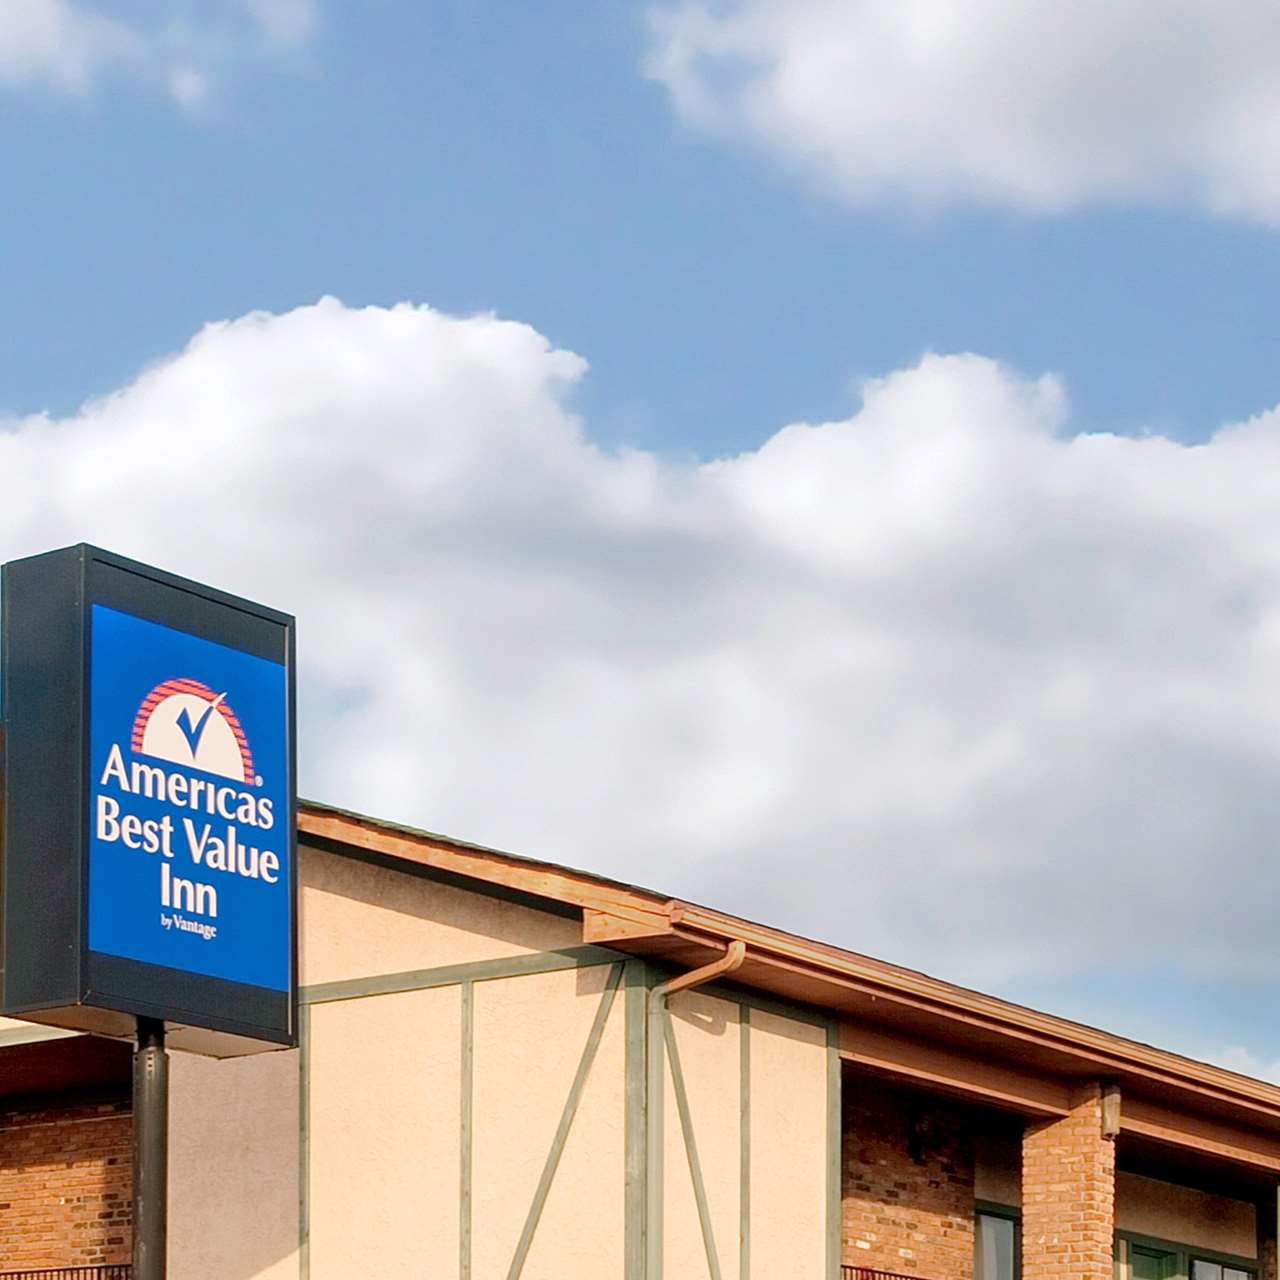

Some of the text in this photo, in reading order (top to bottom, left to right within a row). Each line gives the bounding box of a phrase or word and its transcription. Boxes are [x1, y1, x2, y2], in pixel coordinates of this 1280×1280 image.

[100, 743, 274, 830] Americas
[96, 795, 280, 884] Best Value
[160, 862, 218, 918] Inn
[160, 912, 218, 940] by Vantage
